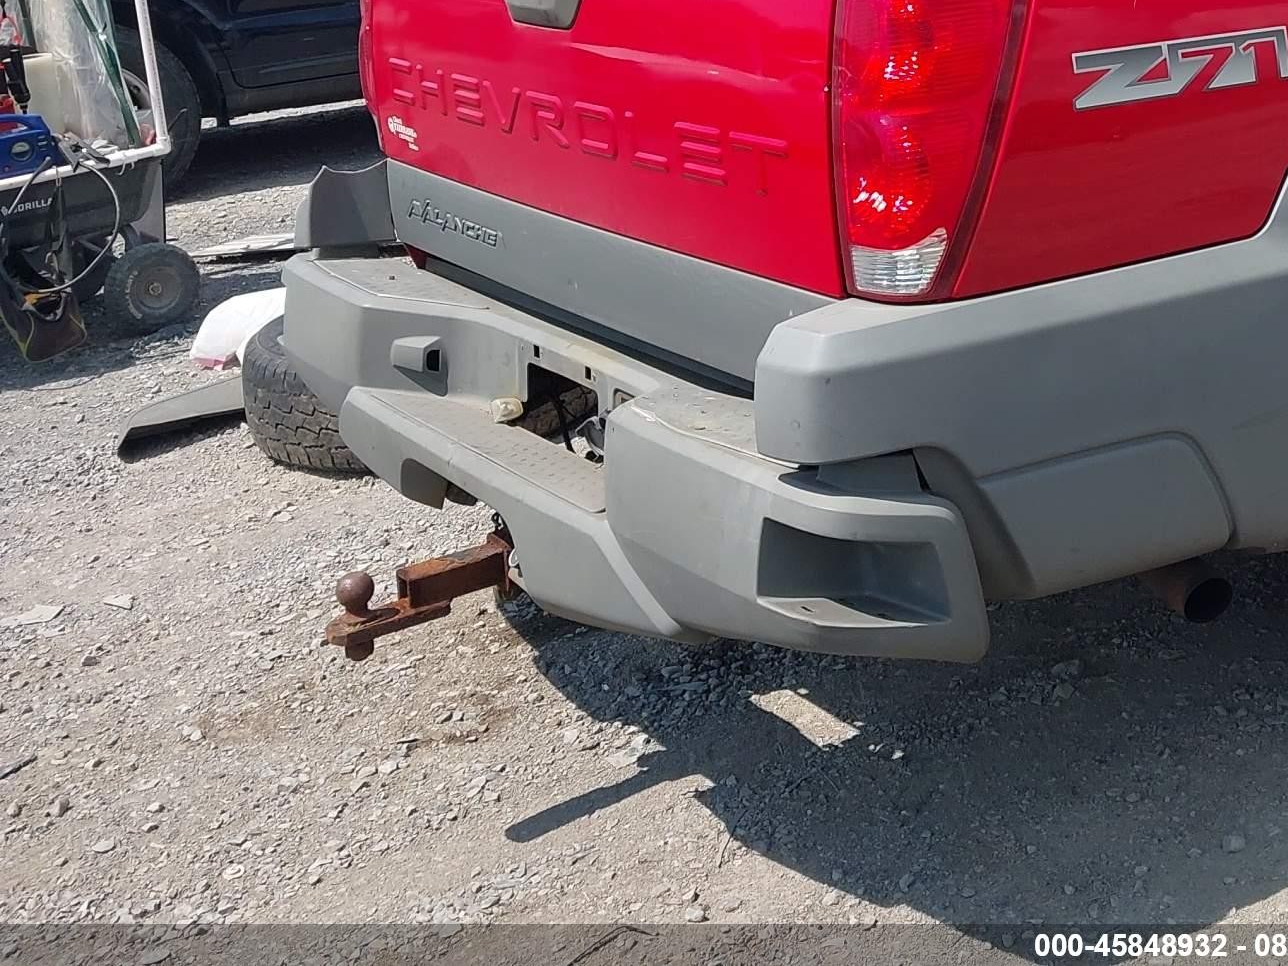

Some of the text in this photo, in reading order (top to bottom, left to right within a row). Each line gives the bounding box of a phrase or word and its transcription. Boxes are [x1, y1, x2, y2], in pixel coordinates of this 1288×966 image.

[388, 57, 789, 196] CHEVROLET
[13, 197, 53, 214] ORILLA
[408, 199, 499, 247] AVALANCHE
